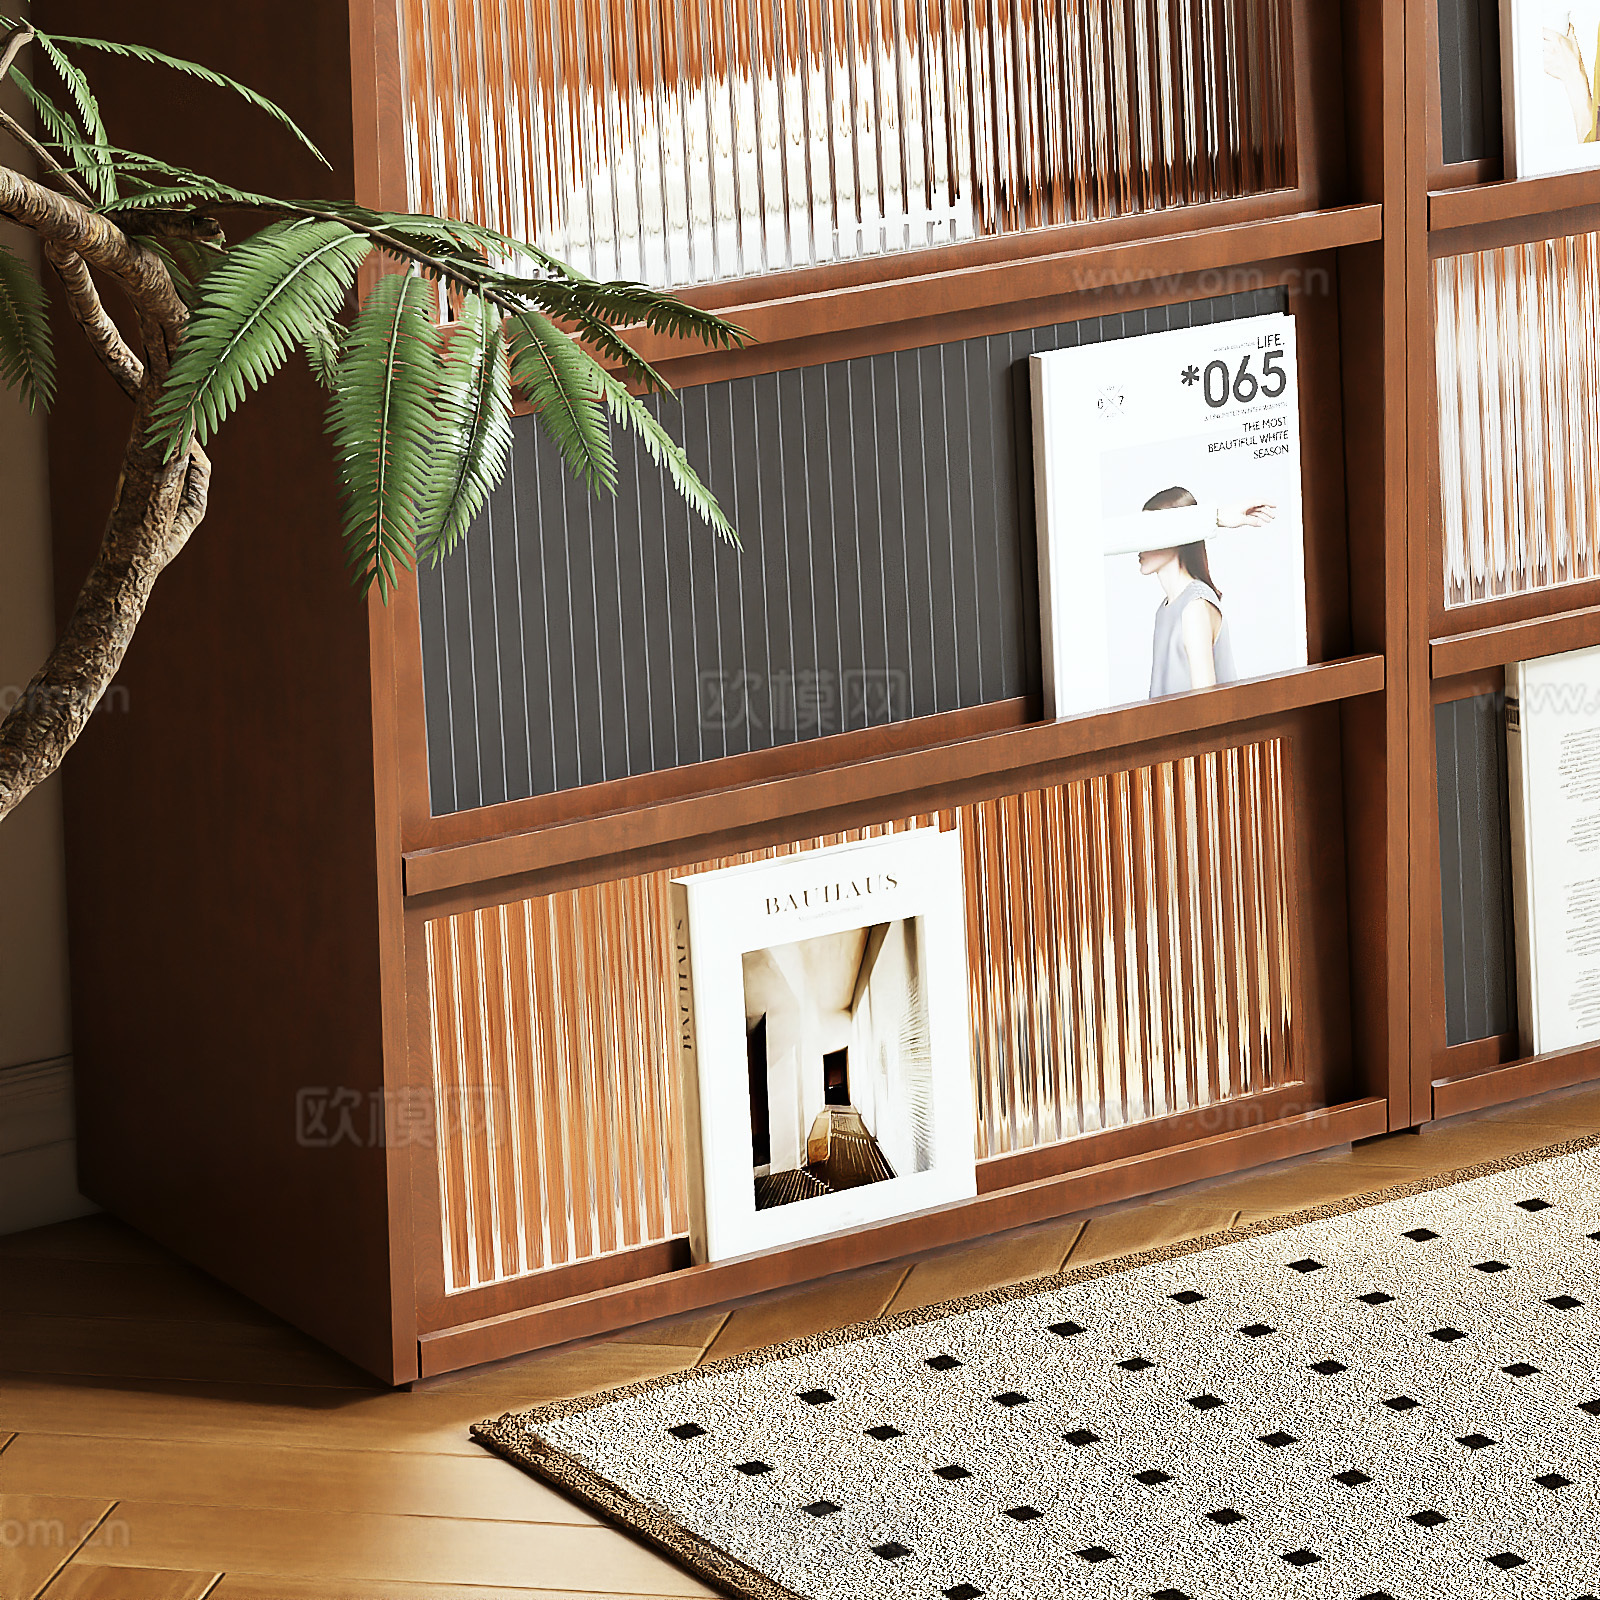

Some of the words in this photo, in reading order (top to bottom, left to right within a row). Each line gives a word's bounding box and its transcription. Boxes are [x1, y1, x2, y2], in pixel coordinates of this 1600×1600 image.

[1262, 416, 1287, 430] MOST
[1207, 435, 1258, 453] BEAUTIFUL
[1253, 444, 1289, 460] SEASON
[765, 872, 898, 915] BAUHAUS
